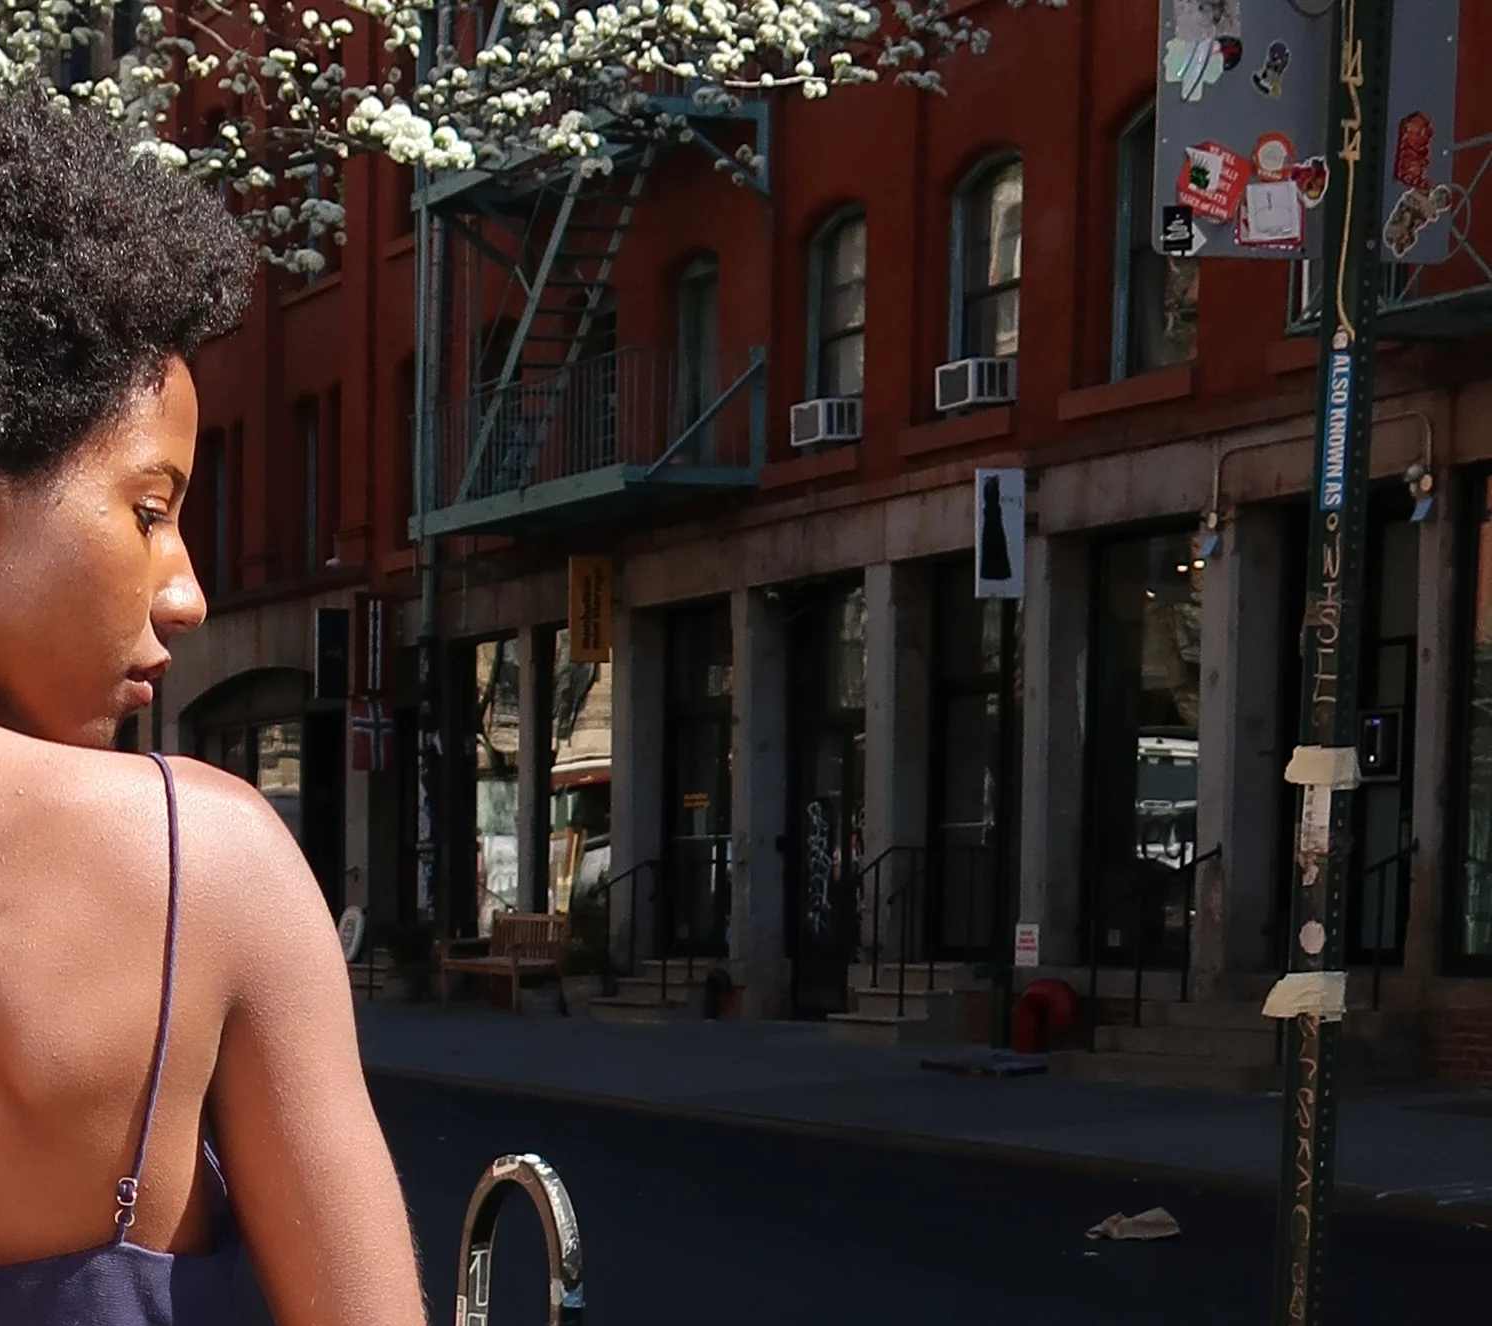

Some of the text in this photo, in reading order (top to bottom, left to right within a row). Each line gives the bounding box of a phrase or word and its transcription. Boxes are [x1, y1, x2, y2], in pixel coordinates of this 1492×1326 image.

[1324, 354, 1351, 506] ALSO KNOWN AS
